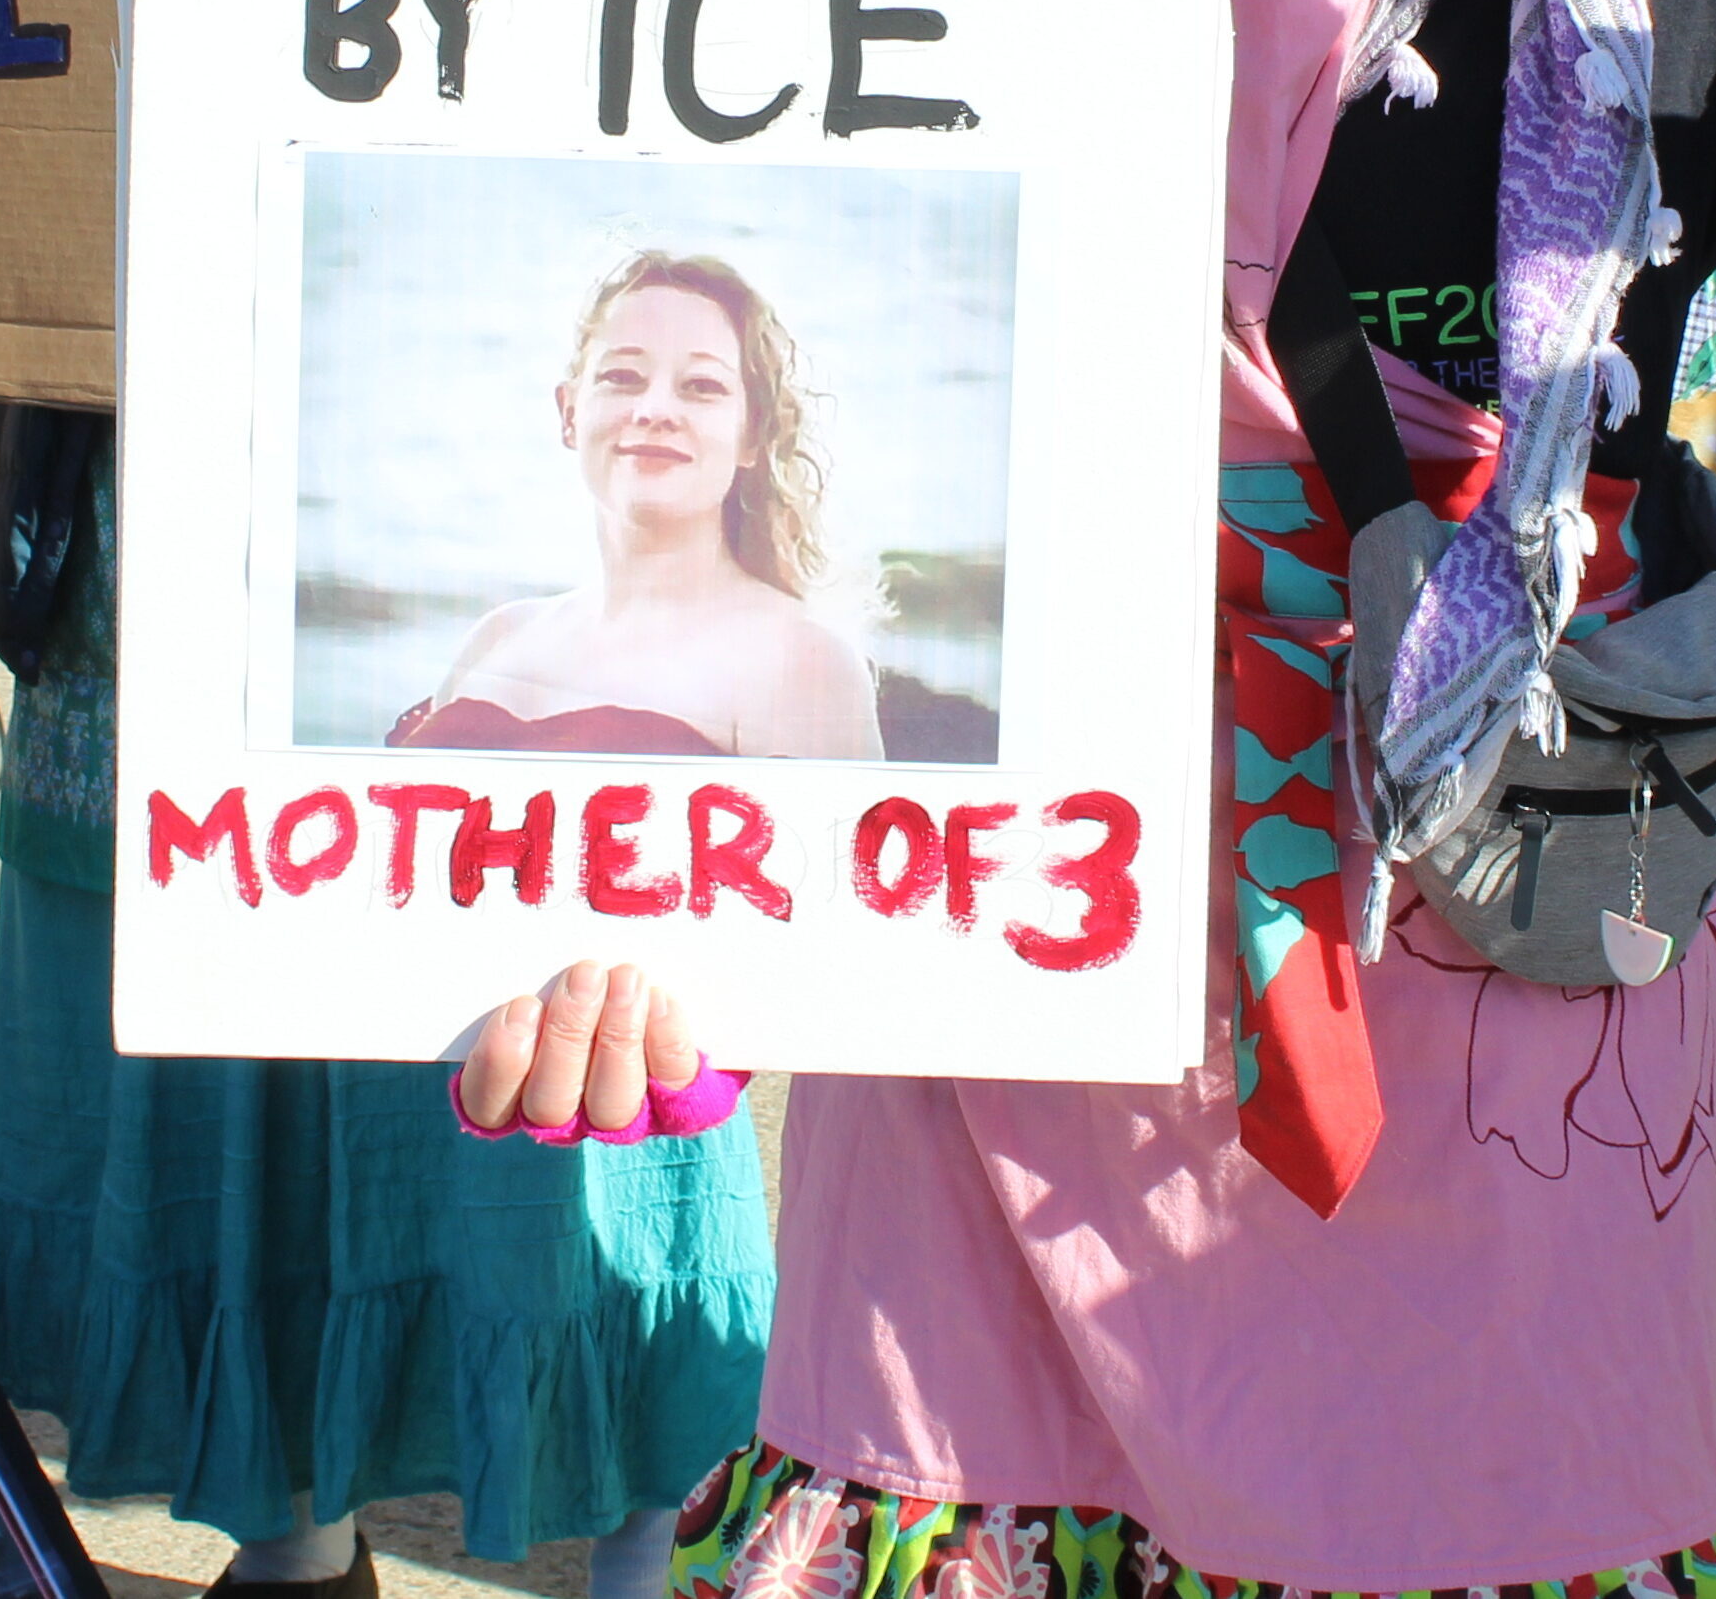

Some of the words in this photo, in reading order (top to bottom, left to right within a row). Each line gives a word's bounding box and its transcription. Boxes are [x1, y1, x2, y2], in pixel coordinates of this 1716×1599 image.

[146, 778, 793, 921] MOTHER
[847, 795, 1019, 933] OF
[1001, 789, 1143, 973] 3
